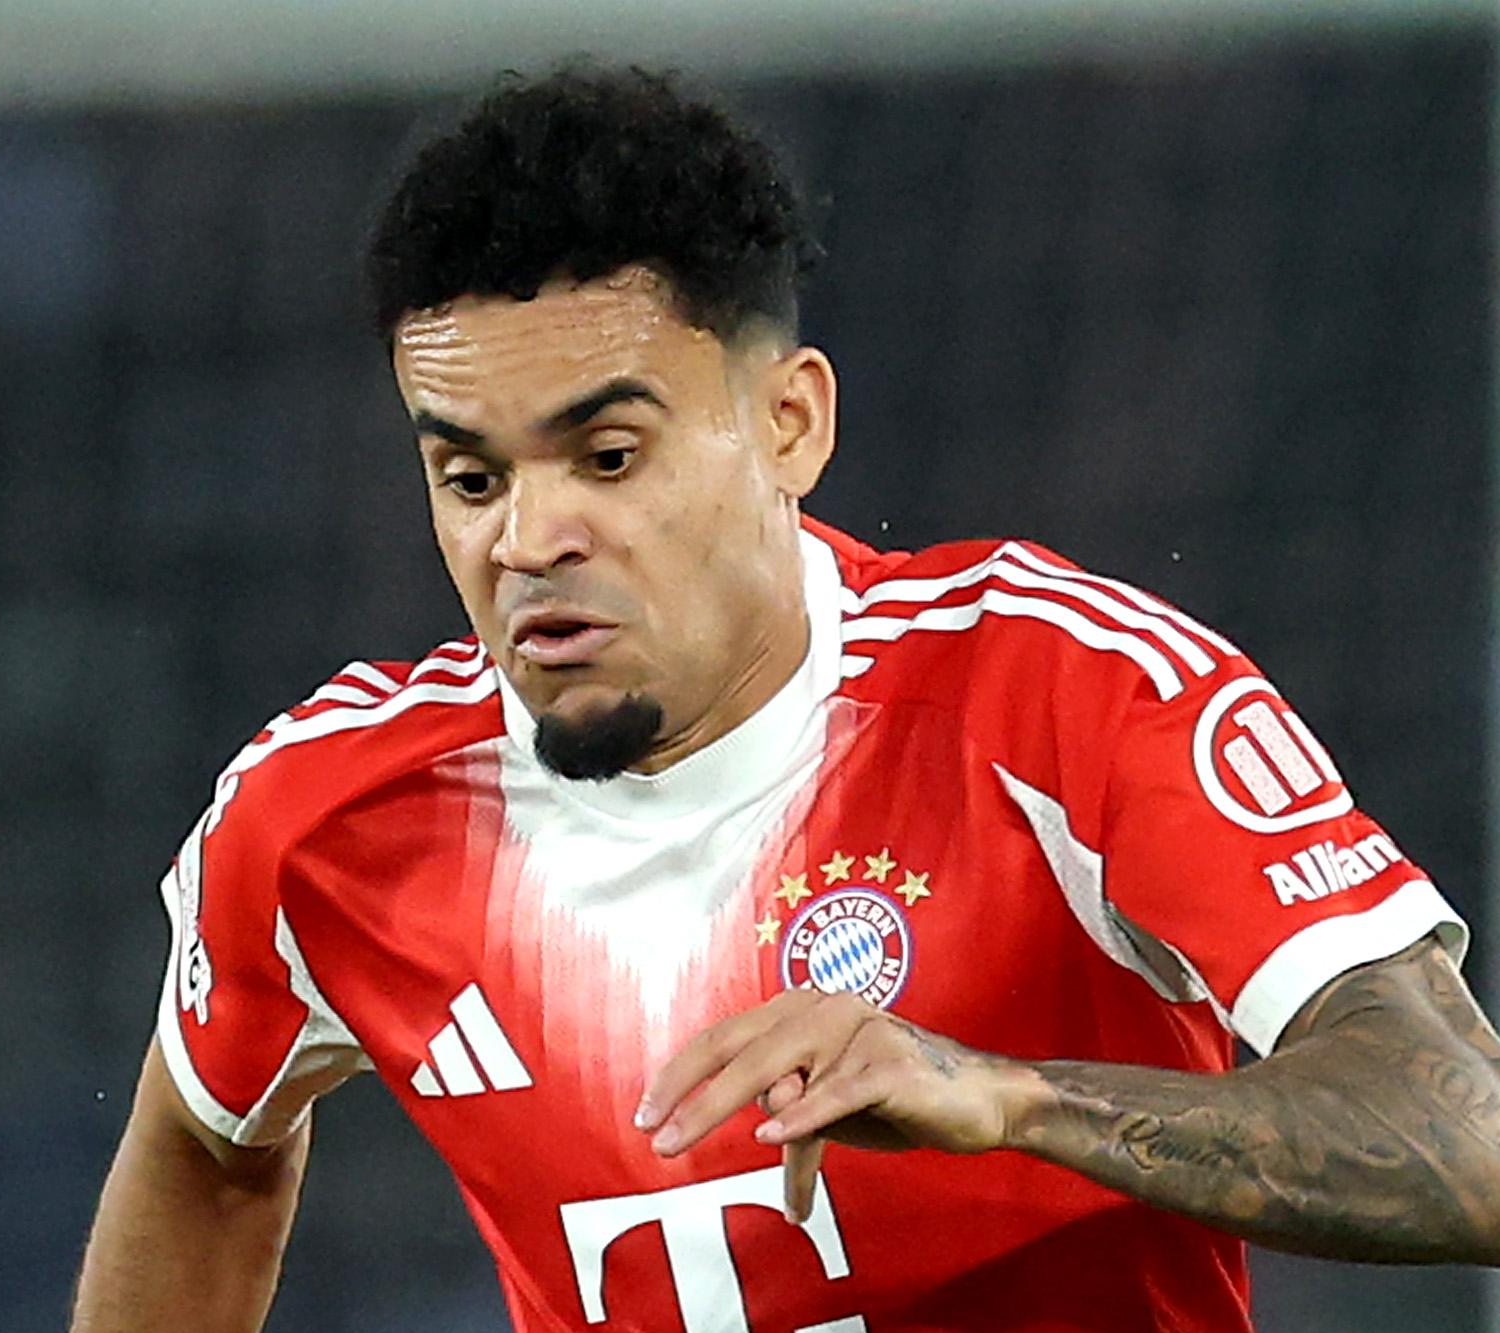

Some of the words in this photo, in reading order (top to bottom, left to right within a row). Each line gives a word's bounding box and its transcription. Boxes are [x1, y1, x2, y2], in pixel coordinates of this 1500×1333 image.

[1263, 834, 1404, 906] Allian
[791, 929, 815, 959] FC
[812, 898, 896, 938] BAYERN
